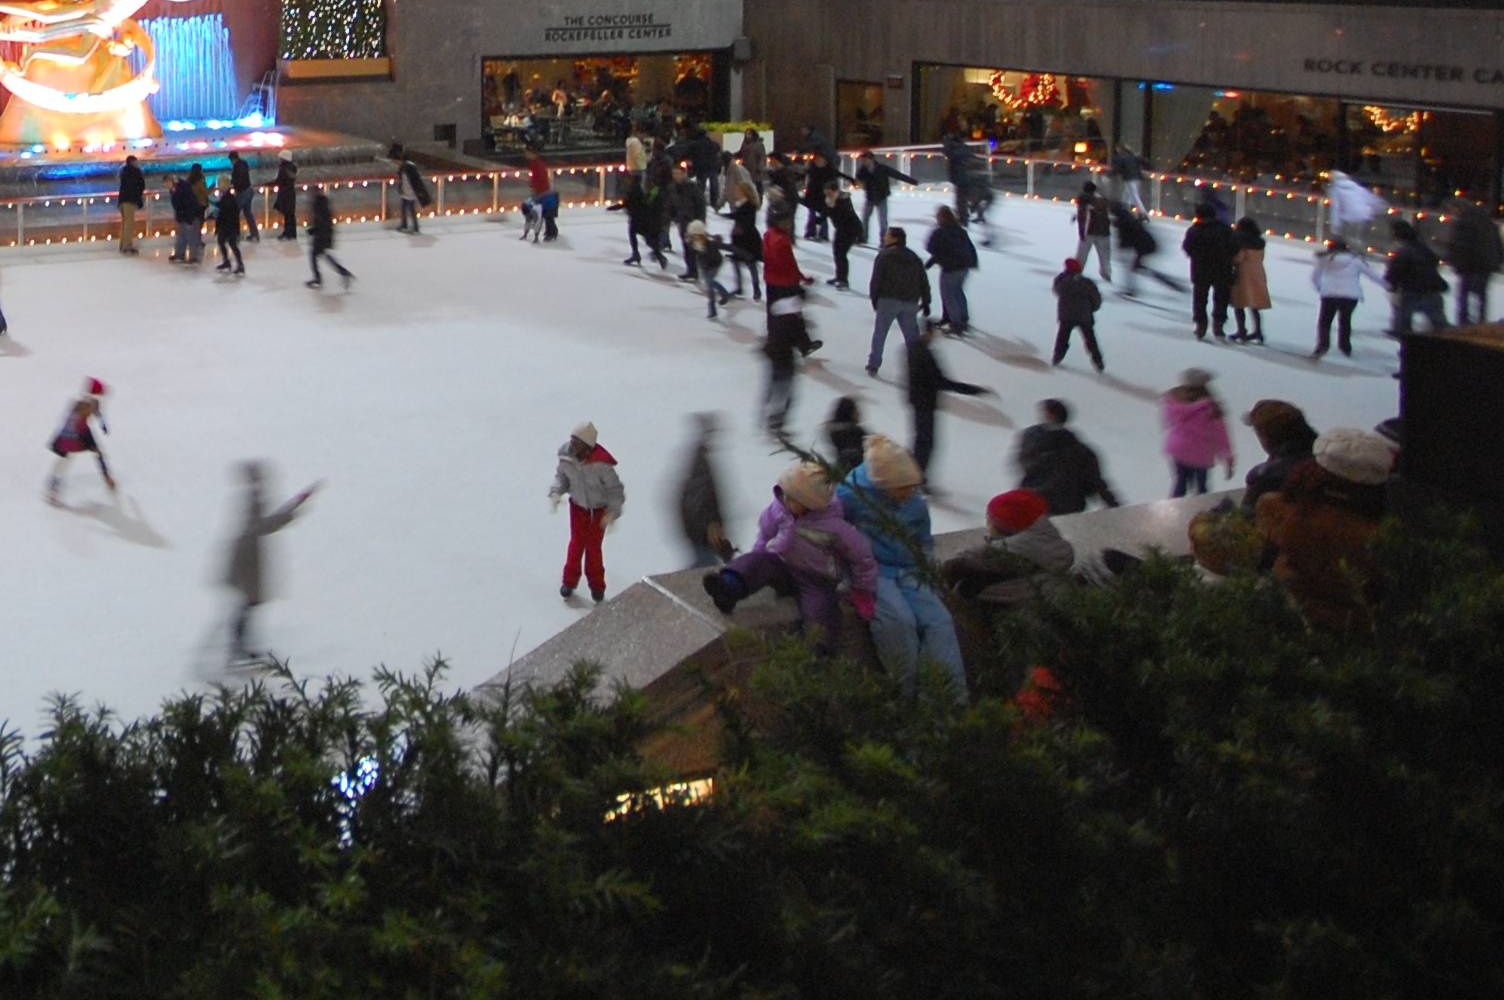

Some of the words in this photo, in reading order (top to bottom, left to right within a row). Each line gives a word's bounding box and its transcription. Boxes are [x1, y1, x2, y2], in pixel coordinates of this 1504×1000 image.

[563, 15, 584, 26] THE
[587, 13, 654, 26] CONCOURSE
[544, 29, 624, 42] ROCKEFELLER
[628, 27, 673, 40] CENTER
[1303, 57, 1363, 76] ROCK
[1370, 61, 1465, 83] CENTER
